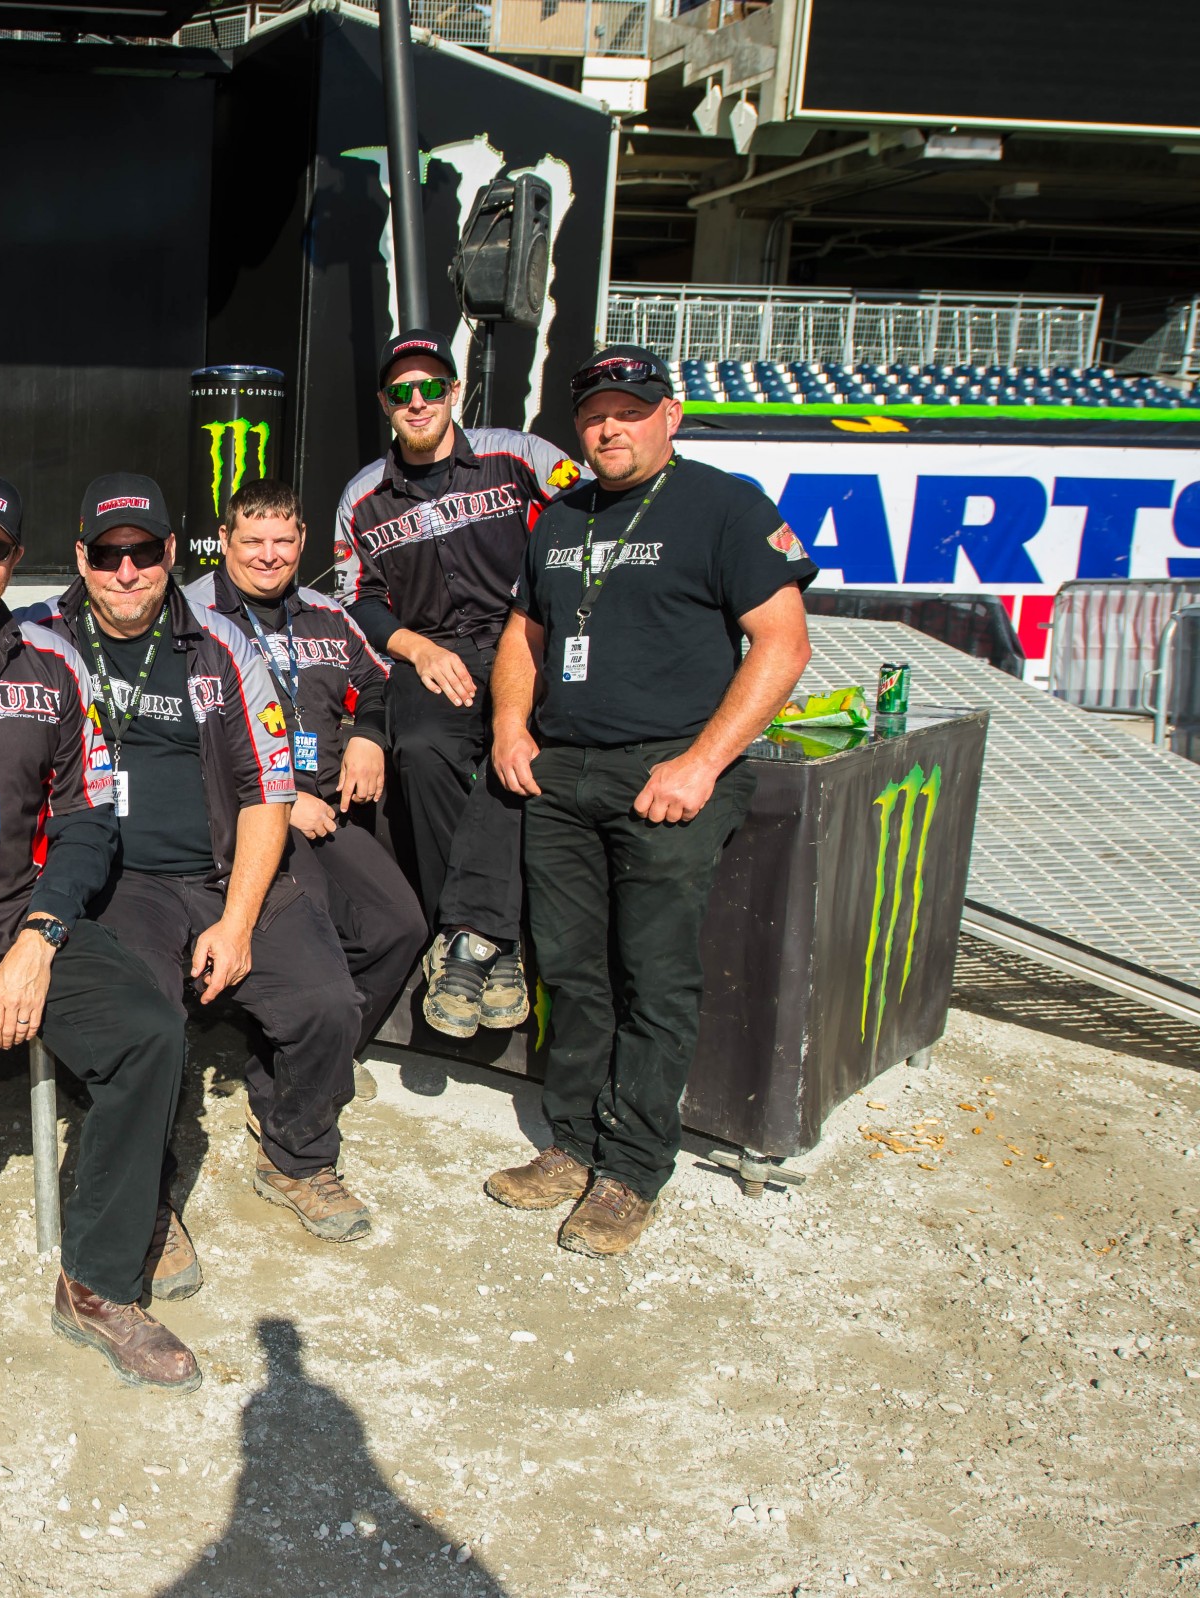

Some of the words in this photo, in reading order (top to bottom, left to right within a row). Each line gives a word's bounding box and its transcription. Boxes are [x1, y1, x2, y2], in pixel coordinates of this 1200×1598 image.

[191, 388, 237, 396] TAURINE
[361, 510, 423, 555] DIRT
[432, 483, 522, 525] WURX
[730, 472, 1200, 585] ART
[90, 748, 111, 769] 100
